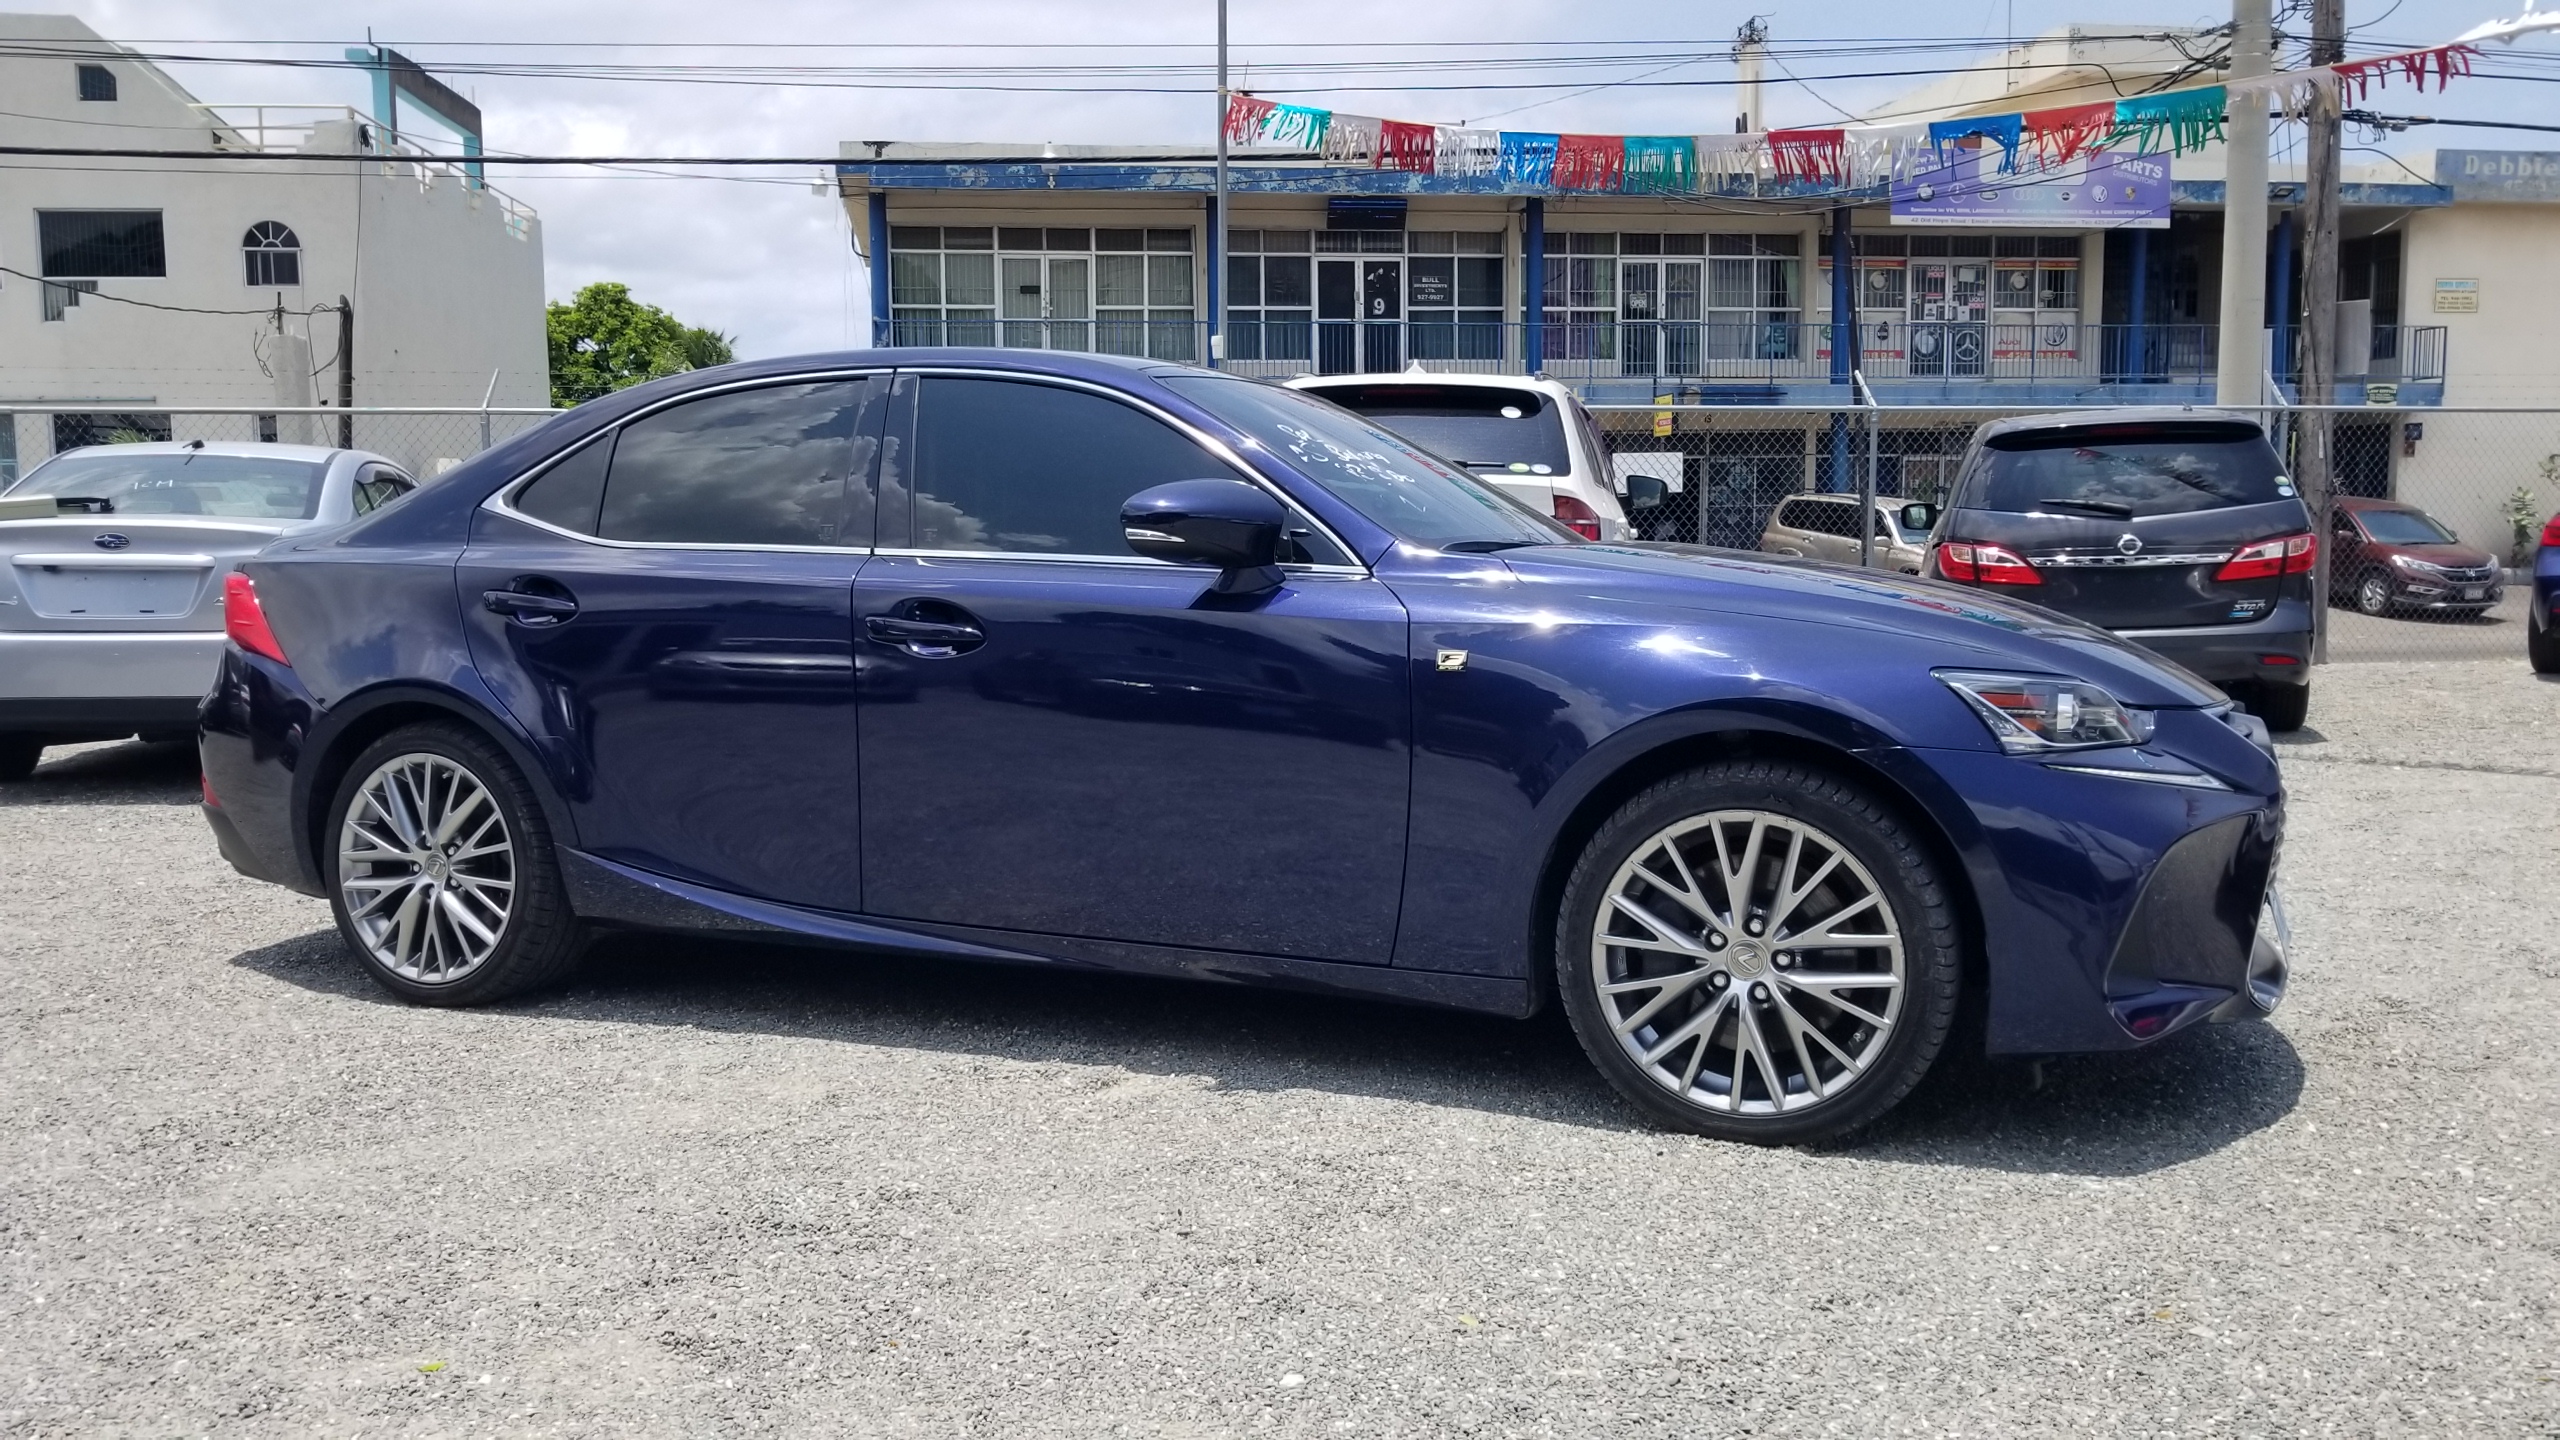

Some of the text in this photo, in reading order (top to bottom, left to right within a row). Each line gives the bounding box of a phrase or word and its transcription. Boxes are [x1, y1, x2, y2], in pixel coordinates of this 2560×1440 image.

[2112, 154, 2163, 179] PARTS
[2112, 170, 2158, 187] DISTRIBUTORS
[1372, 298, 1385, 315] 9
